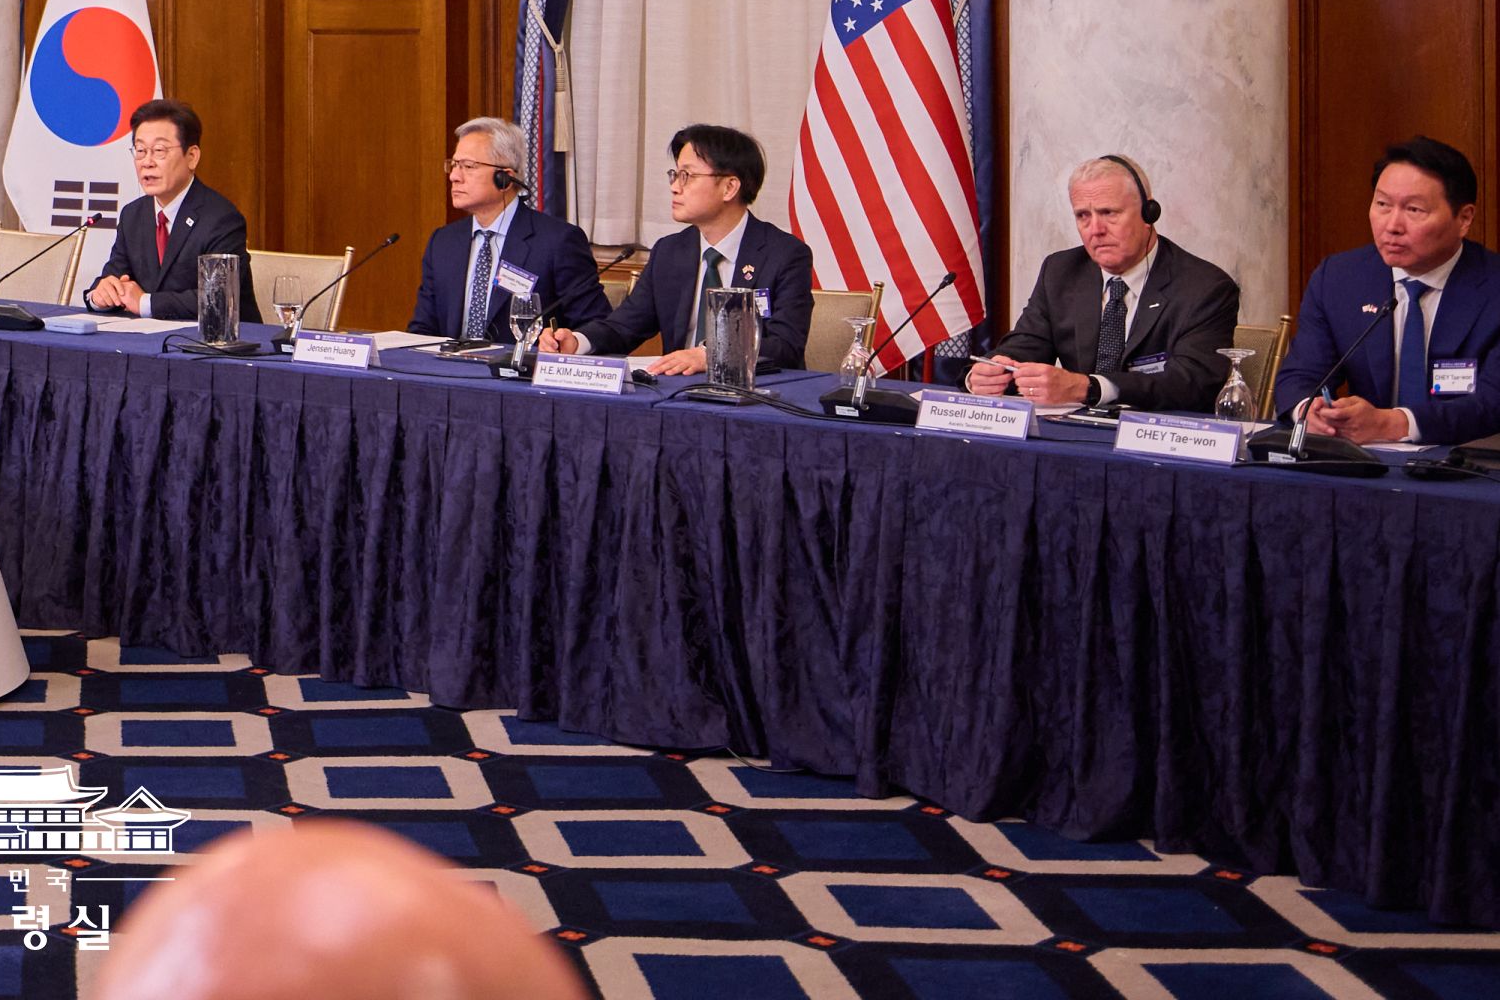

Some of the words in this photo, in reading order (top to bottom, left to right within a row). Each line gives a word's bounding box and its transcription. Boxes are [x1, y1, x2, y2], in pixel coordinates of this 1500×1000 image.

[307, 344, 332, 354] Jensen
[333, 346, 356, 357] Huang
[540, 366, 555, 375] H.E.
[556, 367, 573, 376] KIM
[573, 368, 618, 380] Jung-kwan
[930, 406, 967, 418] Russell
[968, 410, 993, 422] John
[995, 413, 1017, 424] Low
[1135, 428, 1168, 441] CHEY
[1169, 432, 1216, 447] Tae-won
